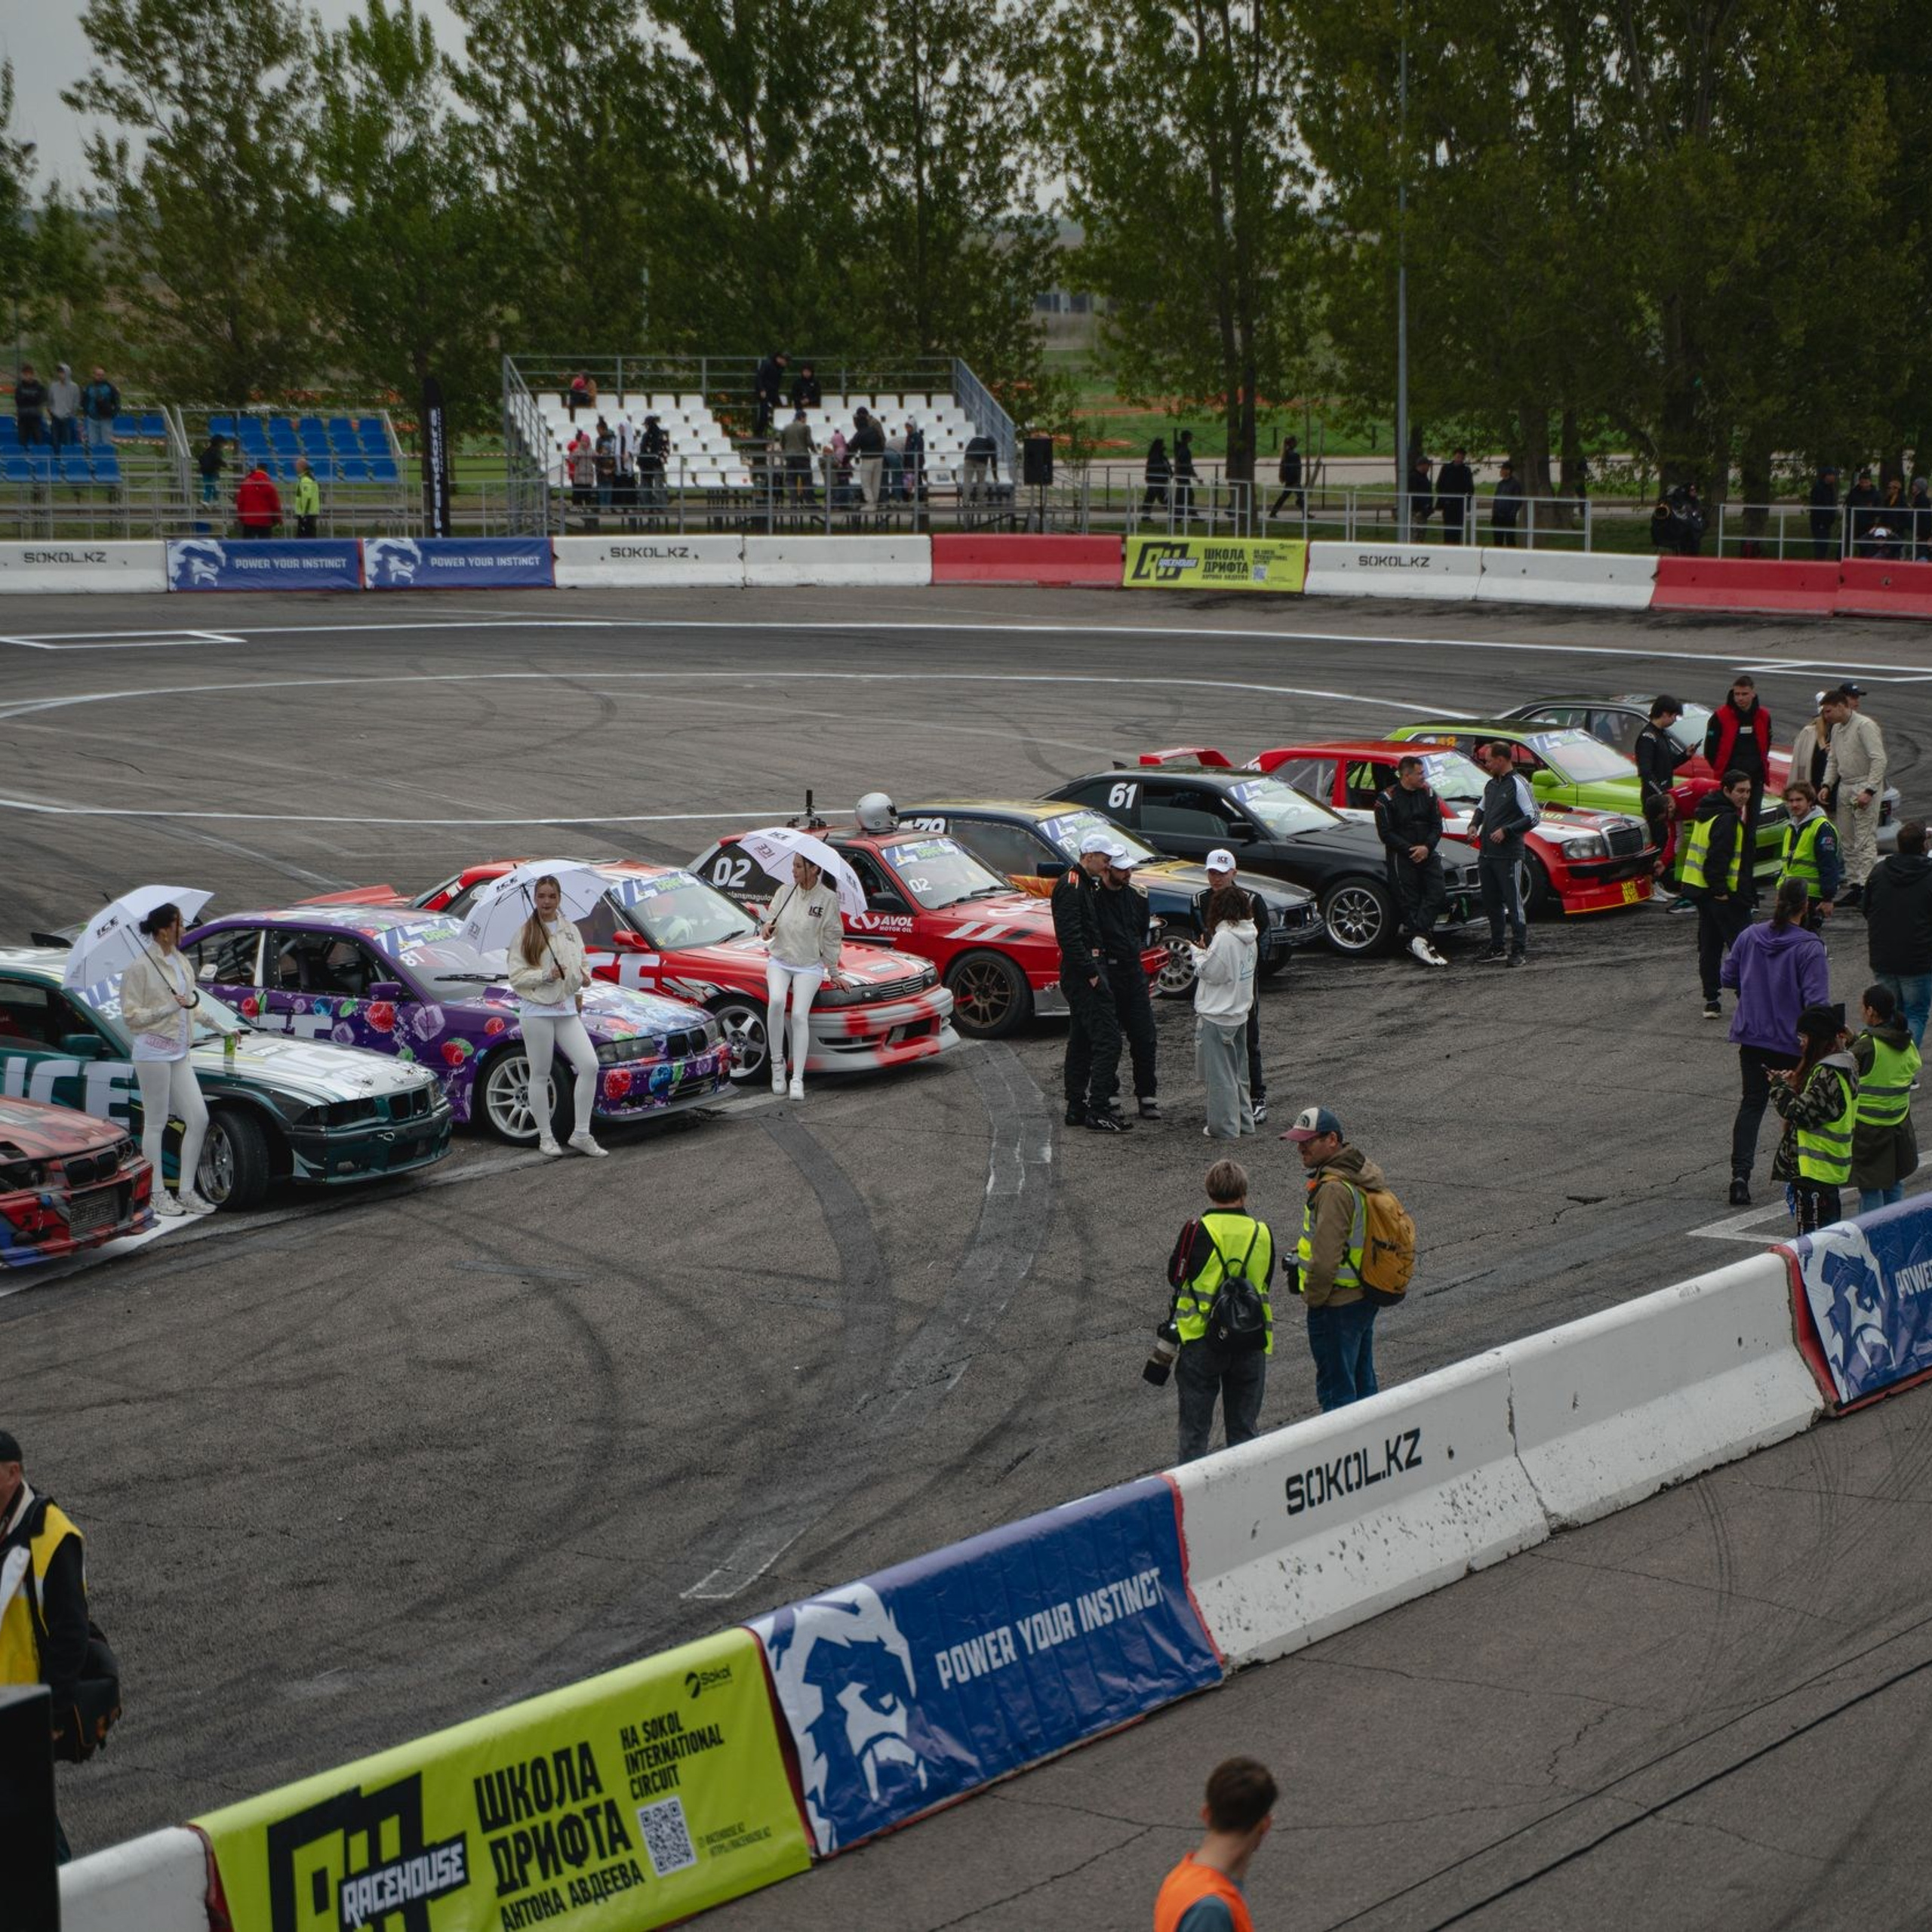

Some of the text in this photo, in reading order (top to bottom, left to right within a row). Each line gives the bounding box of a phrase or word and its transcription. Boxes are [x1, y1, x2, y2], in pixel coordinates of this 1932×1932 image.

[23, 552, 107, 563] SOKOL.KZ
[430, 556, 540, 567] POWER YOUR INSTINCT
[610, 546, 690, 558] SOKOL.KZ
[1204, 548, 1245, 561] ШКОЛА
[1358, 555, 1431, 568] SOKOL.KZ
[235, 558, 347, 569] POWER YOUR INSTINCT
[1202, 561, 1248, 574] ДРИФТА
[1109, 783, 1137, 809] 61
[770, 831, 791, 841] ICE
[1057, 836, 1077, 852] 79
[712, 857, 752, 888] 02
[909, 878, 932, 893] 02
[809, 906, 824, 916] ICE
[881, 915, 913, 928] AVOL
[97, 915, 118, 937] ICE
[4, 1057, 135, 1131] ICE
[1285, 1427, 1423, 1516] SOKOL.KZ
[934, 1567, 1164, 1690] POWER YOUR INSTINCT
[641, 1710, 684, 1743] SOKOL
[624, 1723, 724, 1777] INTERNATIONAL
[473, 1740, 604, 1835] ШКОЛА
[629, 1764, 681, 1801] CIRCUIT
[489, 1798, 633, 1899] ДРИФТА
[342, 1842, 465, 1928] RACEHOUSE
[500, 1858, 645, 1932] АНТОНА АВДЕЕВА
